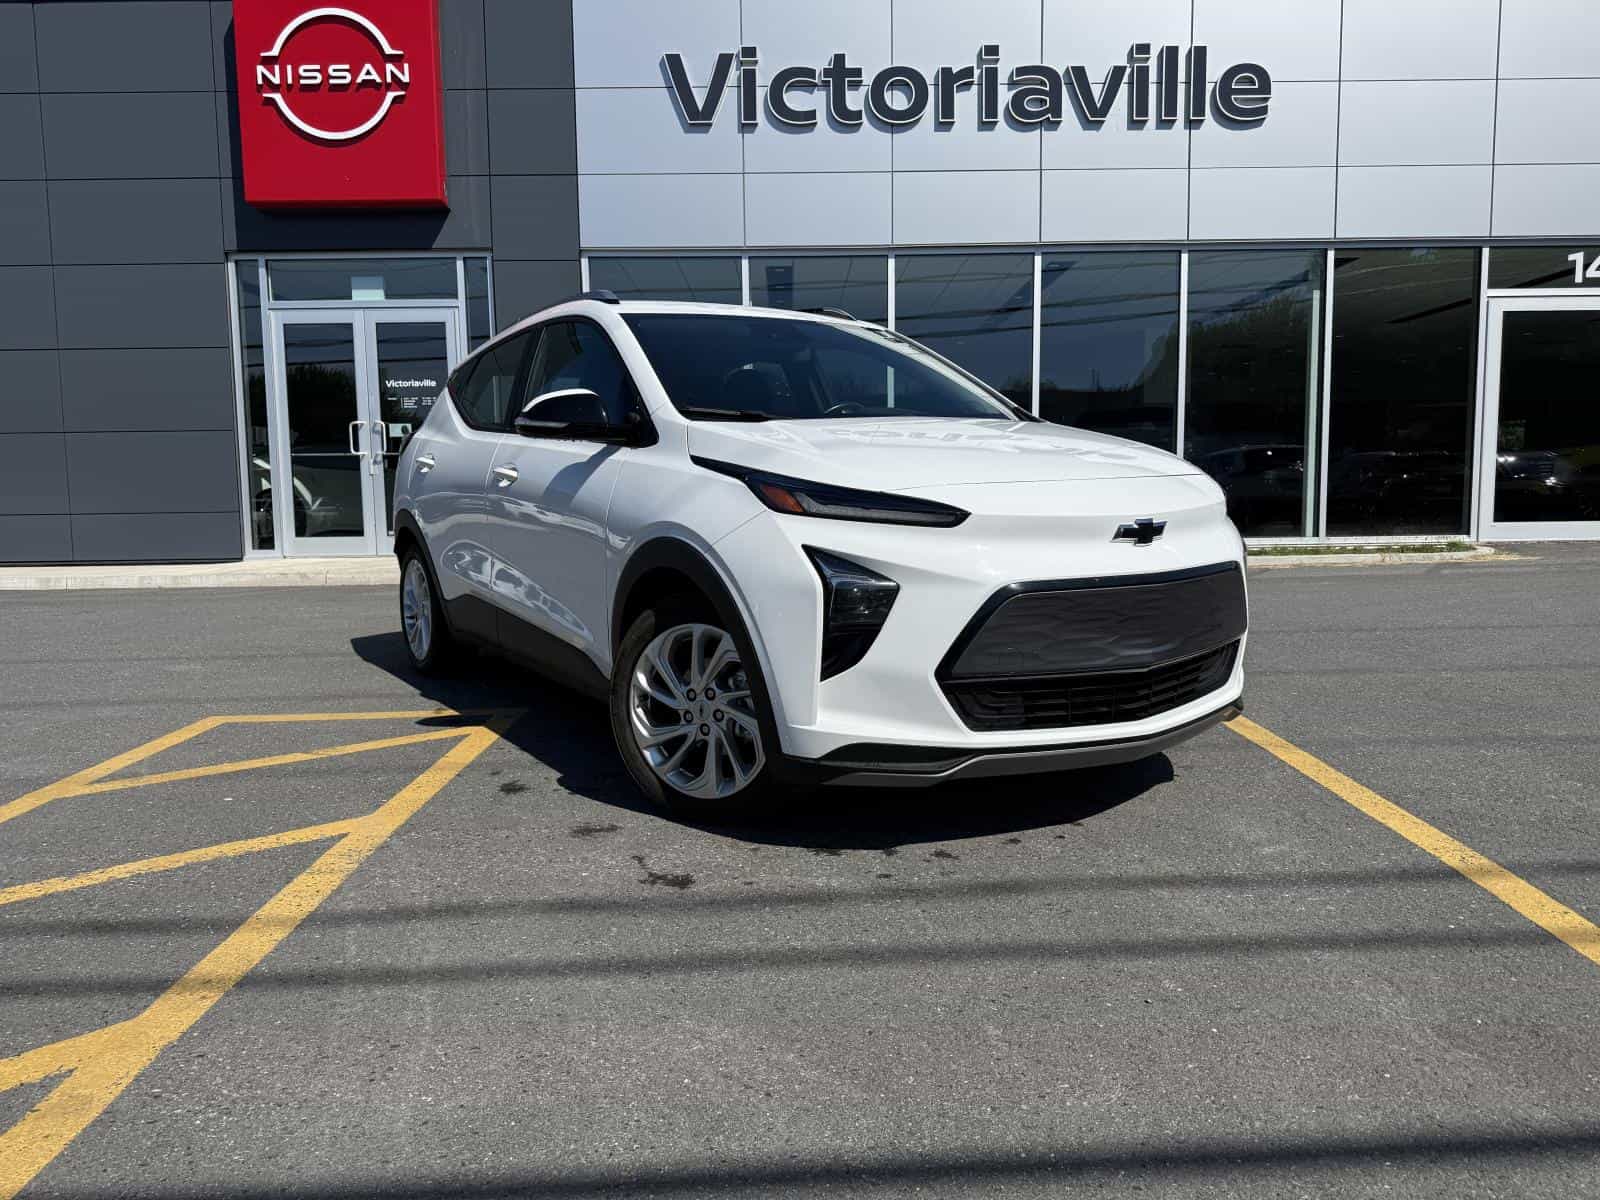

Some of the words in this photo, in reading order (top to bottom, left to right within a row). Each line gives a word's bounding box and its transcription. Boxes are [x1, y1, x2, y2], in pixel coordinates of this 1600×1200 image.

[256, 63, 410, 85] NISSAN
[662, 42, 1272, 126] Victoriaville
[385, 379, 437, 388] Victoriaville
